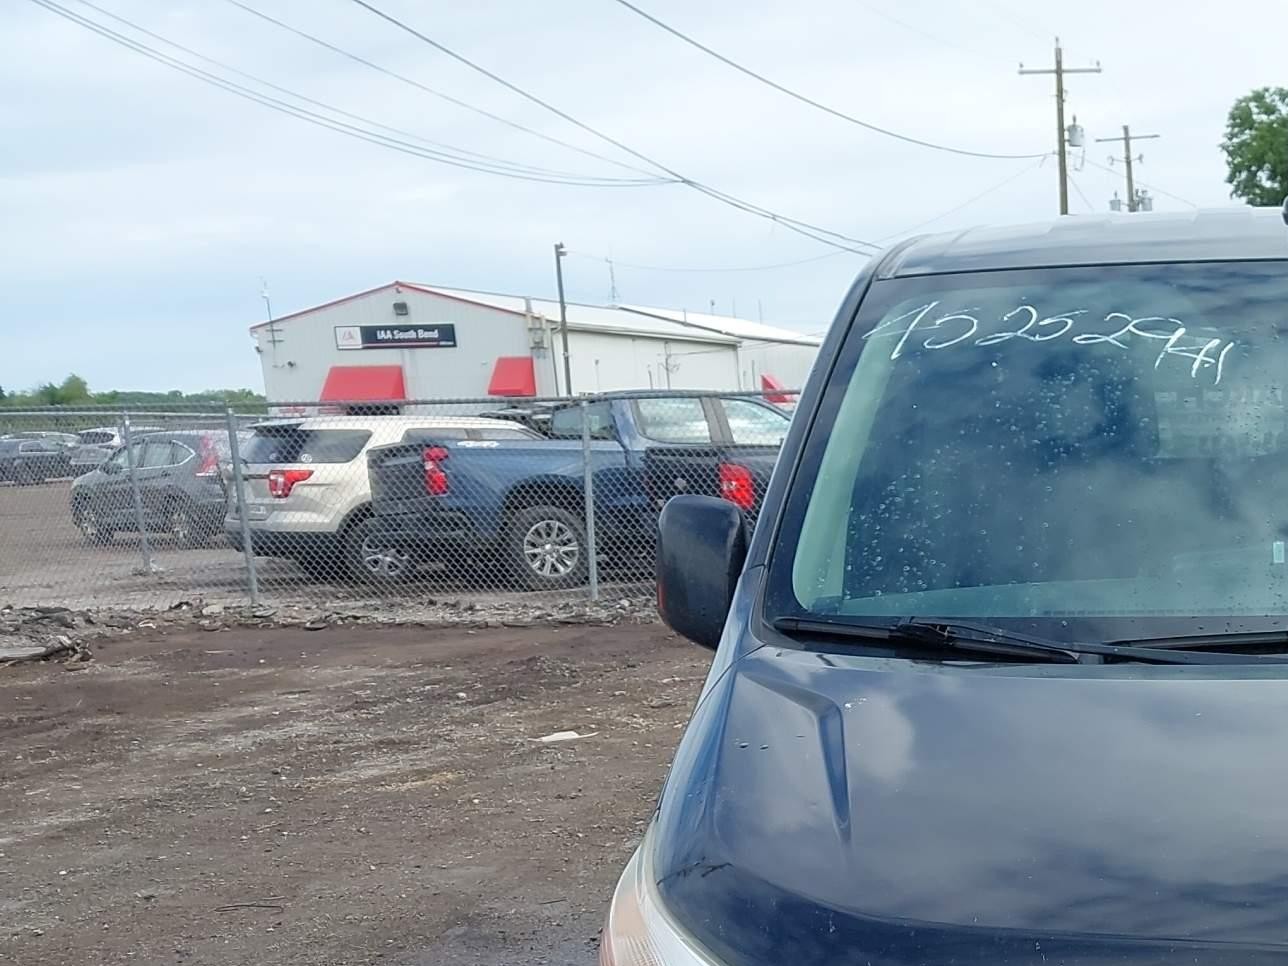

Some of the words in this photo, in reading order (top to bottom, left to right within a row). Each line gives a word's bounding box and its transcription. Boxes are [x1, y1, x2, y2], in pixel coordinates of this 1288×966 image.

[376, 329, 392, 341] IAA
[393, 329, 417, 340] South
[418, 328, 439, 339] Bend
